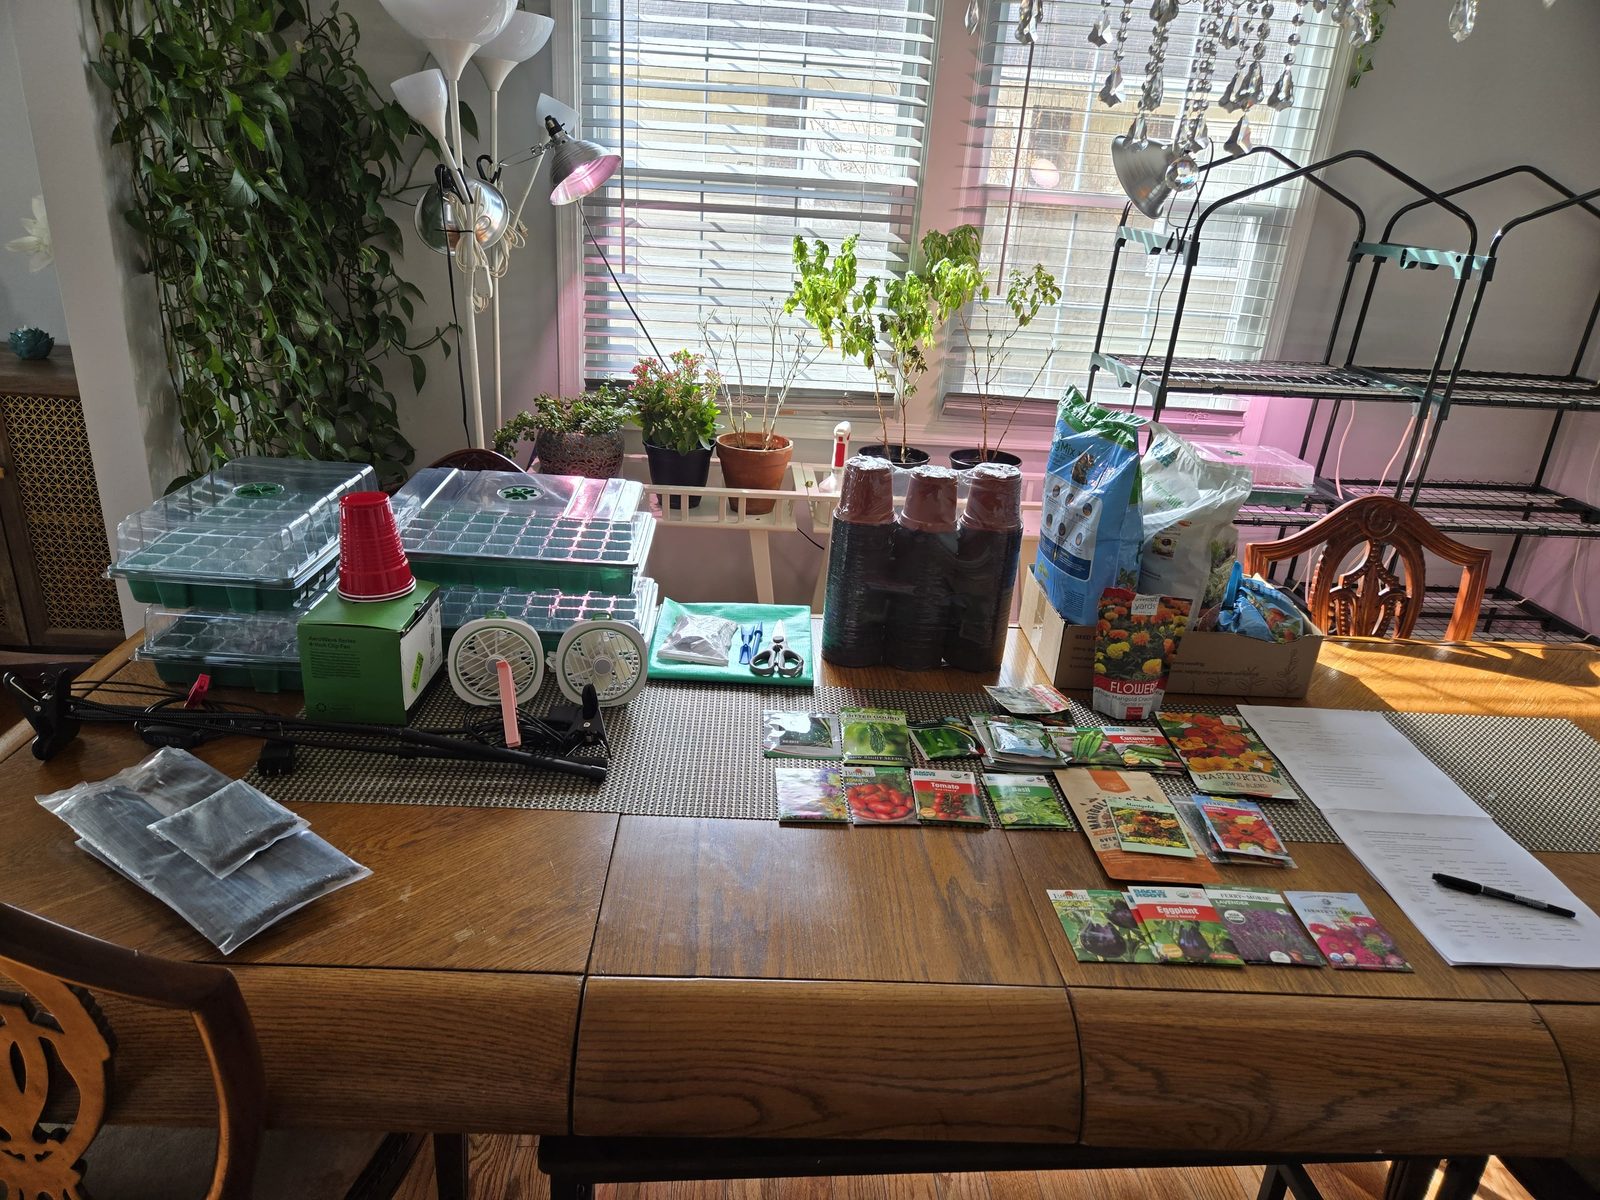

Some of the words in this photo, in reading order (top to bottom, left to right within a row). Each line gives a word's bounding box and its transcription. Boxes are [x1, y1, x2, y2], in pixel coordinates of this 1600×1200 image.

[1197, 772, 1283, 785] NASTURTIUM
[930, 782, 960, 790] Tomato
[1156, 906, 1200, 915] Eggplant
